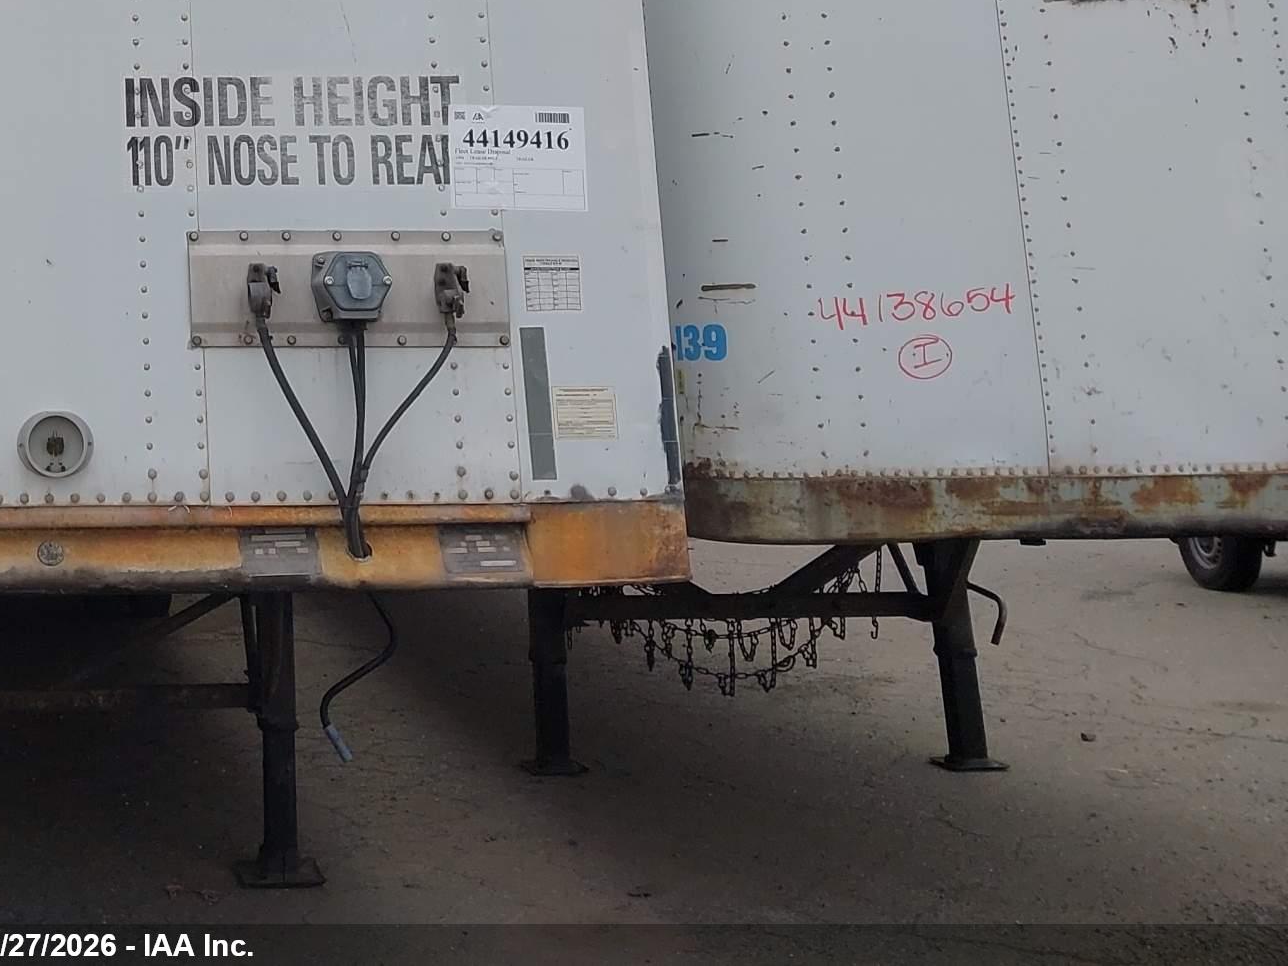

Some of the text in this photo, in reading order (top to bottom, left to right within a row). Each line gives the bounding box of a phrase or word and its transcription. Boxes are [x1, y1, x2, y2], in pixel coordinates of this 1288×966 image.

[126, 75, 459, 127] INSIDE HEIGHT
[126, 135, 190, 186] 110"
[207, 135, 300, 186] NOSE
[308, 135, 355, 186] TO
[462, 128, 570, 150] 44149416
[817, 283, 1016, 331] 44138654
